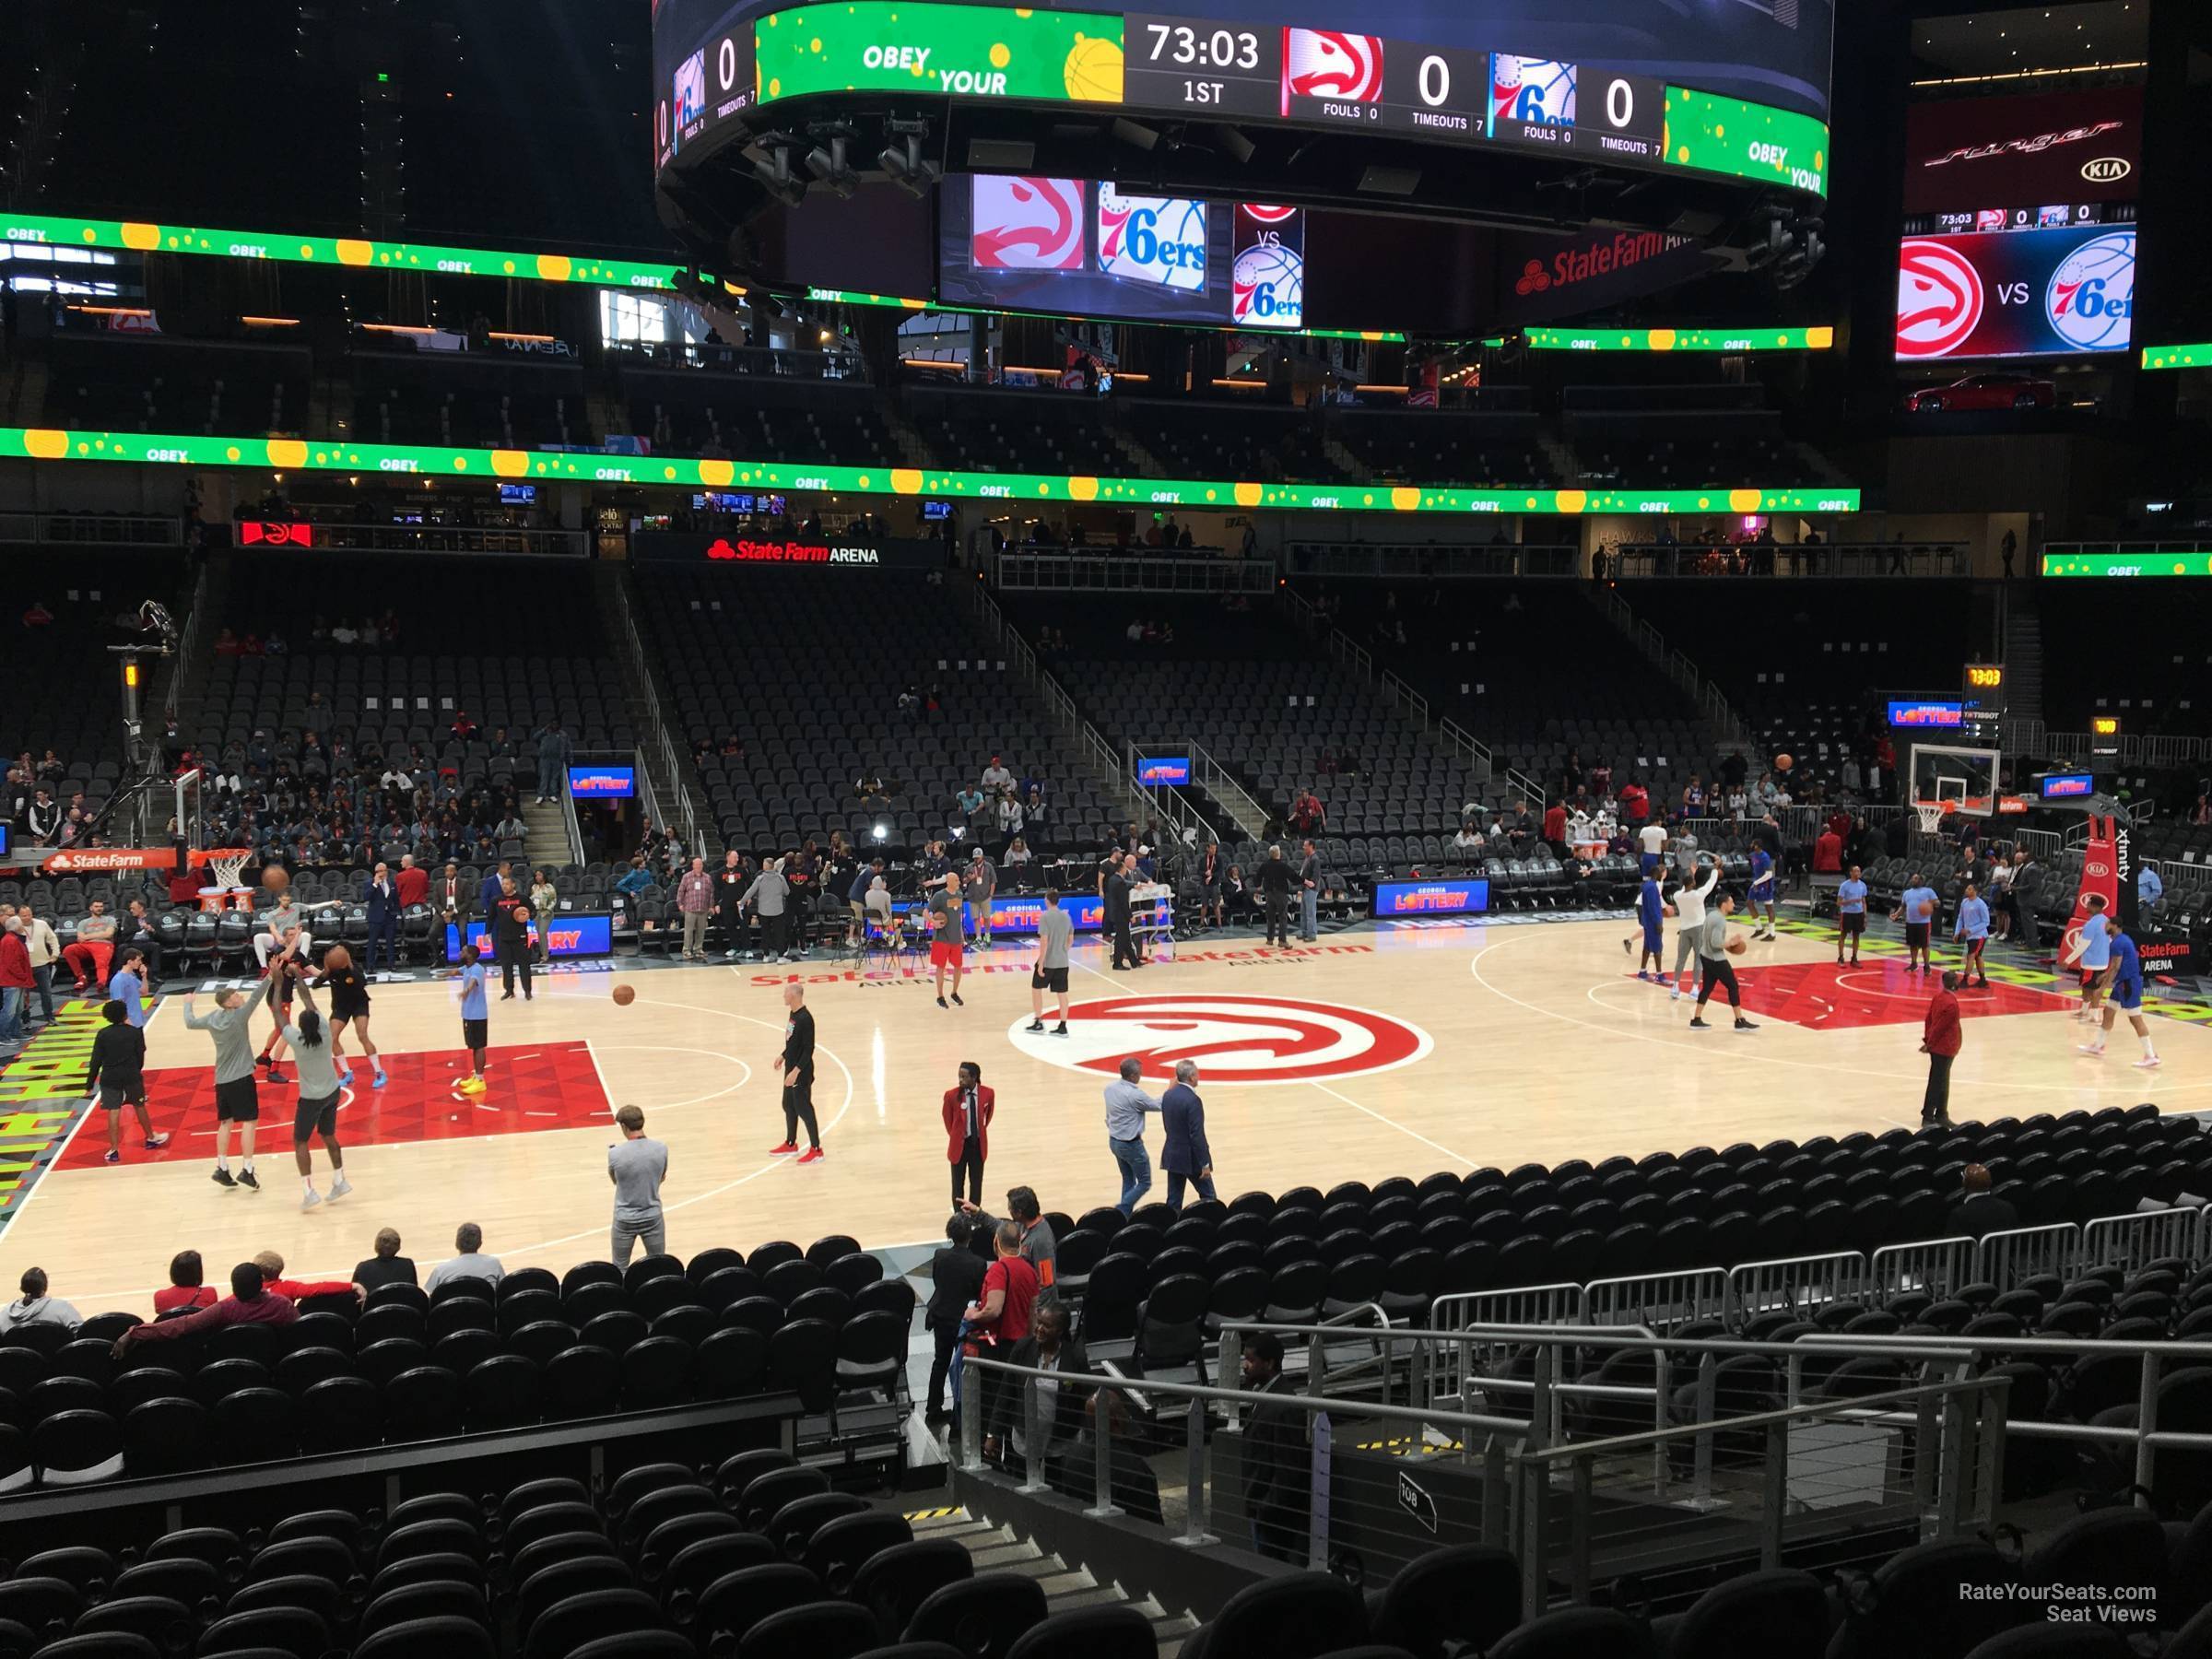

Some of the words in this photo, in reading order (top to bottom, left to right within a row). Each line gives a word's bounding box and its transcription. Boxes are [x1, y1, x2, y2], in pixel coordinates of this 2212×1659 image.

[1147, 24, 1259, 68] 73:03
[719, 38, 735, 90] 0
[863, 45, 931, 69] OBEY
[939, 69, 1006, 95] YOUR
[1418, 55, 1451, 106] 0
[1184, 82, 1224, 104] 1ST
[717, 94, 746, 118] TIMEOUTS
[1606, 79, 1633, 127] 0
[1324, 103, 1360, 119] FOULS
[1370, 107, 1378, 120] 0
[1413, 112, 1467, 129] TIMEOUTS
[1477, 119, 1483, 131] 7
[1524, 125, 1556, 141] FOULS
[1564, 131, 1571, 144] 0
[1601, 136, 1647, 156] TIMEOUTS
[1654, 145, 1661, 157] 7
[1748, 142, 1788, 164] OBEY
[2089, 162, 2122, 179] KIA
[1790, 168, 1821, 193] YOUR
[2016, 210, 2028, 224] 0
[2078, 205, 2089, 219] 0
[1941, 214, 1972, 225] 73:03
[7, 228, 46, 241] OBEY
[1257, 229, 1280, 249] VS
[229, 243, 266, 258] OBEY
[438, 260, 472, 273] OBEY
[631, 275, 664, 288] OBEY
[812, 288, 842, 301] OBEY
[1997, 282, 2030, 306] VS
[1571, 338, 1597, 349] OBEY
[1724, 338, 1751, 349] OBEY
[147, 449, 188, 462] OBEY
[380, 459, 418, 472] OBEY
[595, 468, 631, 481] OBEY
[795, 477, 829, 490] OBEY
[980, 486, 1011, 497] OBEY
[1151, 492, 1181, 503] OBEY
[1312, 497, 1339, 508] OBEY
[1471, 500, 1500, 512] OBEY
[1640, 501, 1671, 513] OBEY
[1818, 500, 1851, 512] OBEY
[1600, 530, 1656, 545] HAWKS
[830, 548, 878, 563] ARENA
[2107, 566, 2142, 577] OBEY
[1970, 668, 2001, 686] 73:03
[572, 779, 629, 790] LOTTERY
[2089, 864, 2106, 876] KIA
[1394, 891, 1469, 911] LOTTERY
[2144, 959, 2173, 972] ARENA
[1401, 1482, 1418, 1508] 108
